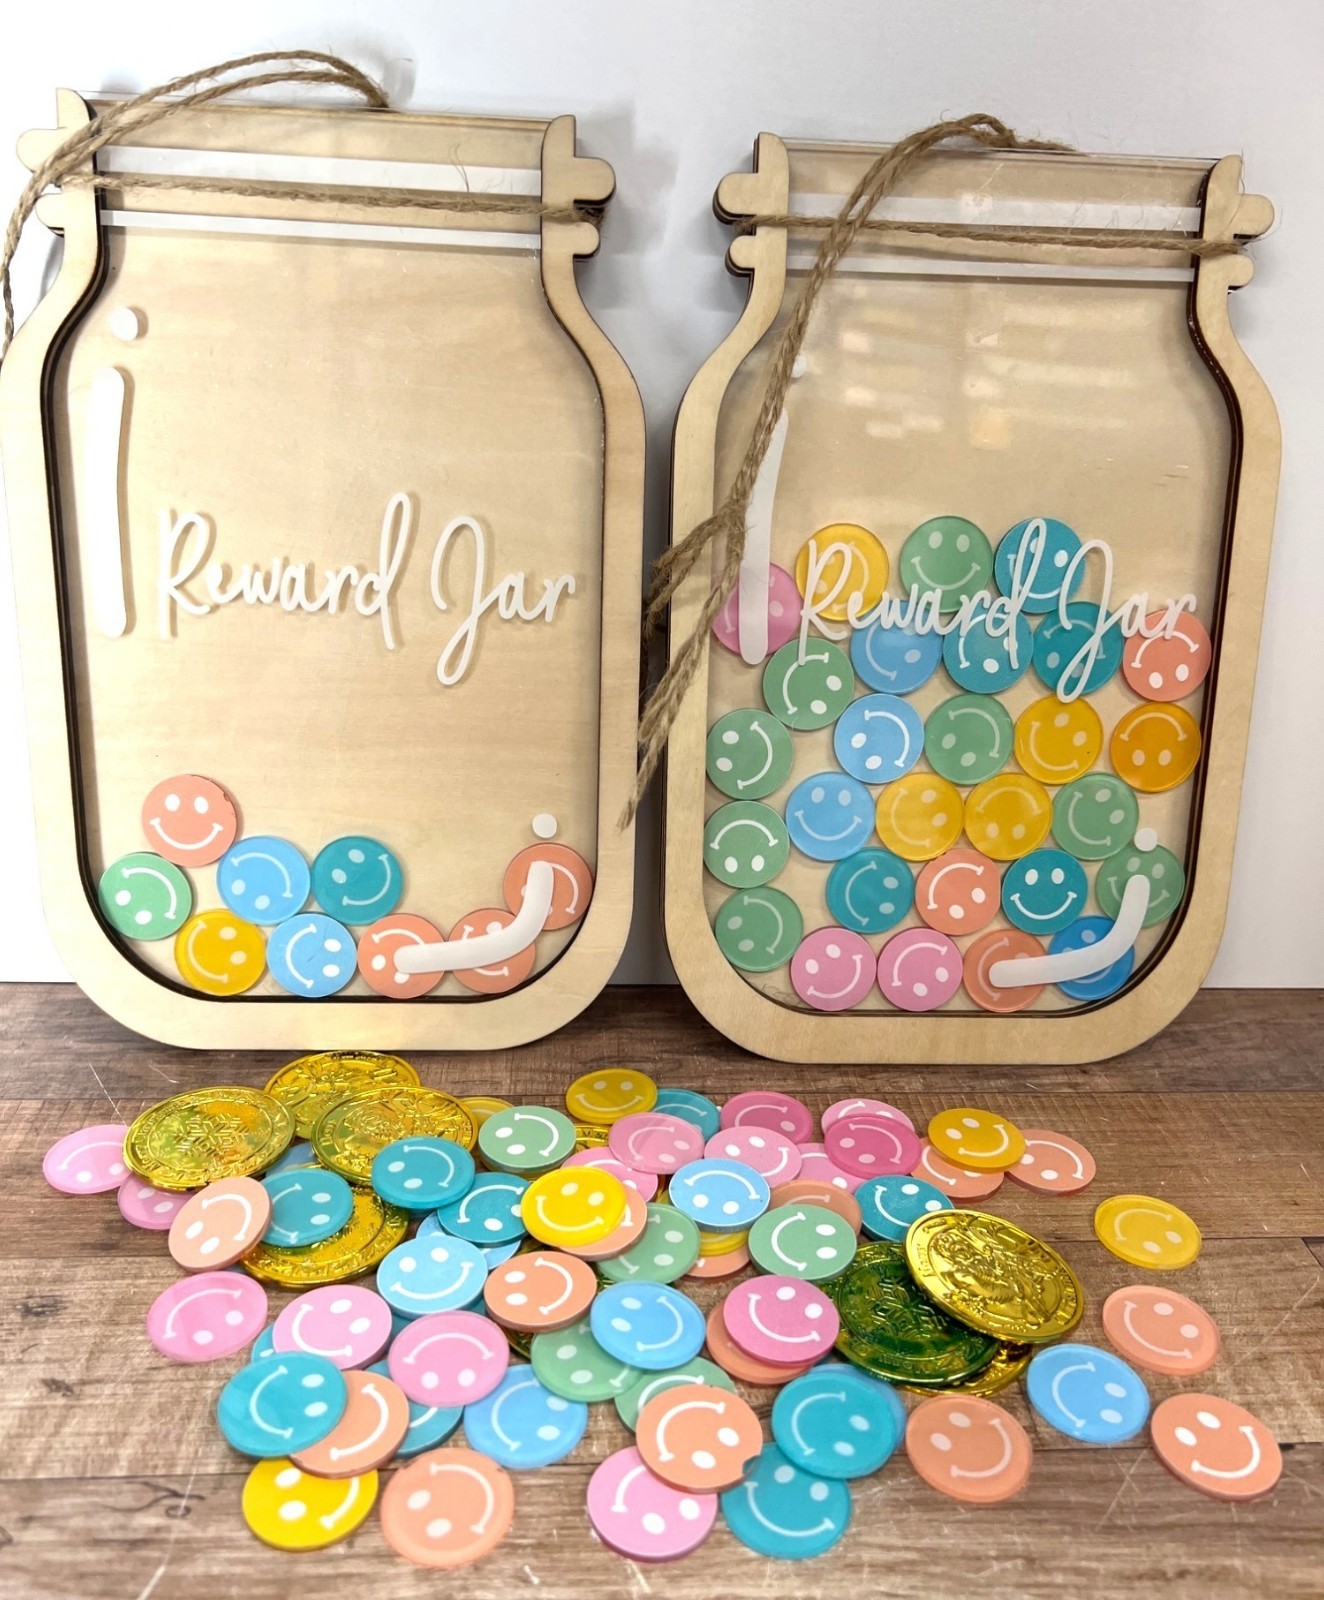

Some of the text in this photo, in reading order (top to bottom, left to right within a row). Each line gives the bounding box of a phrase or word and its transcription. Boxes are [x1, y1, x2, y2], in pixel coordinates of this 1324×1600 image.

[157, 492, 577, 685] Reward Jar
[799, 518, 1197, 703] Reward Jar
